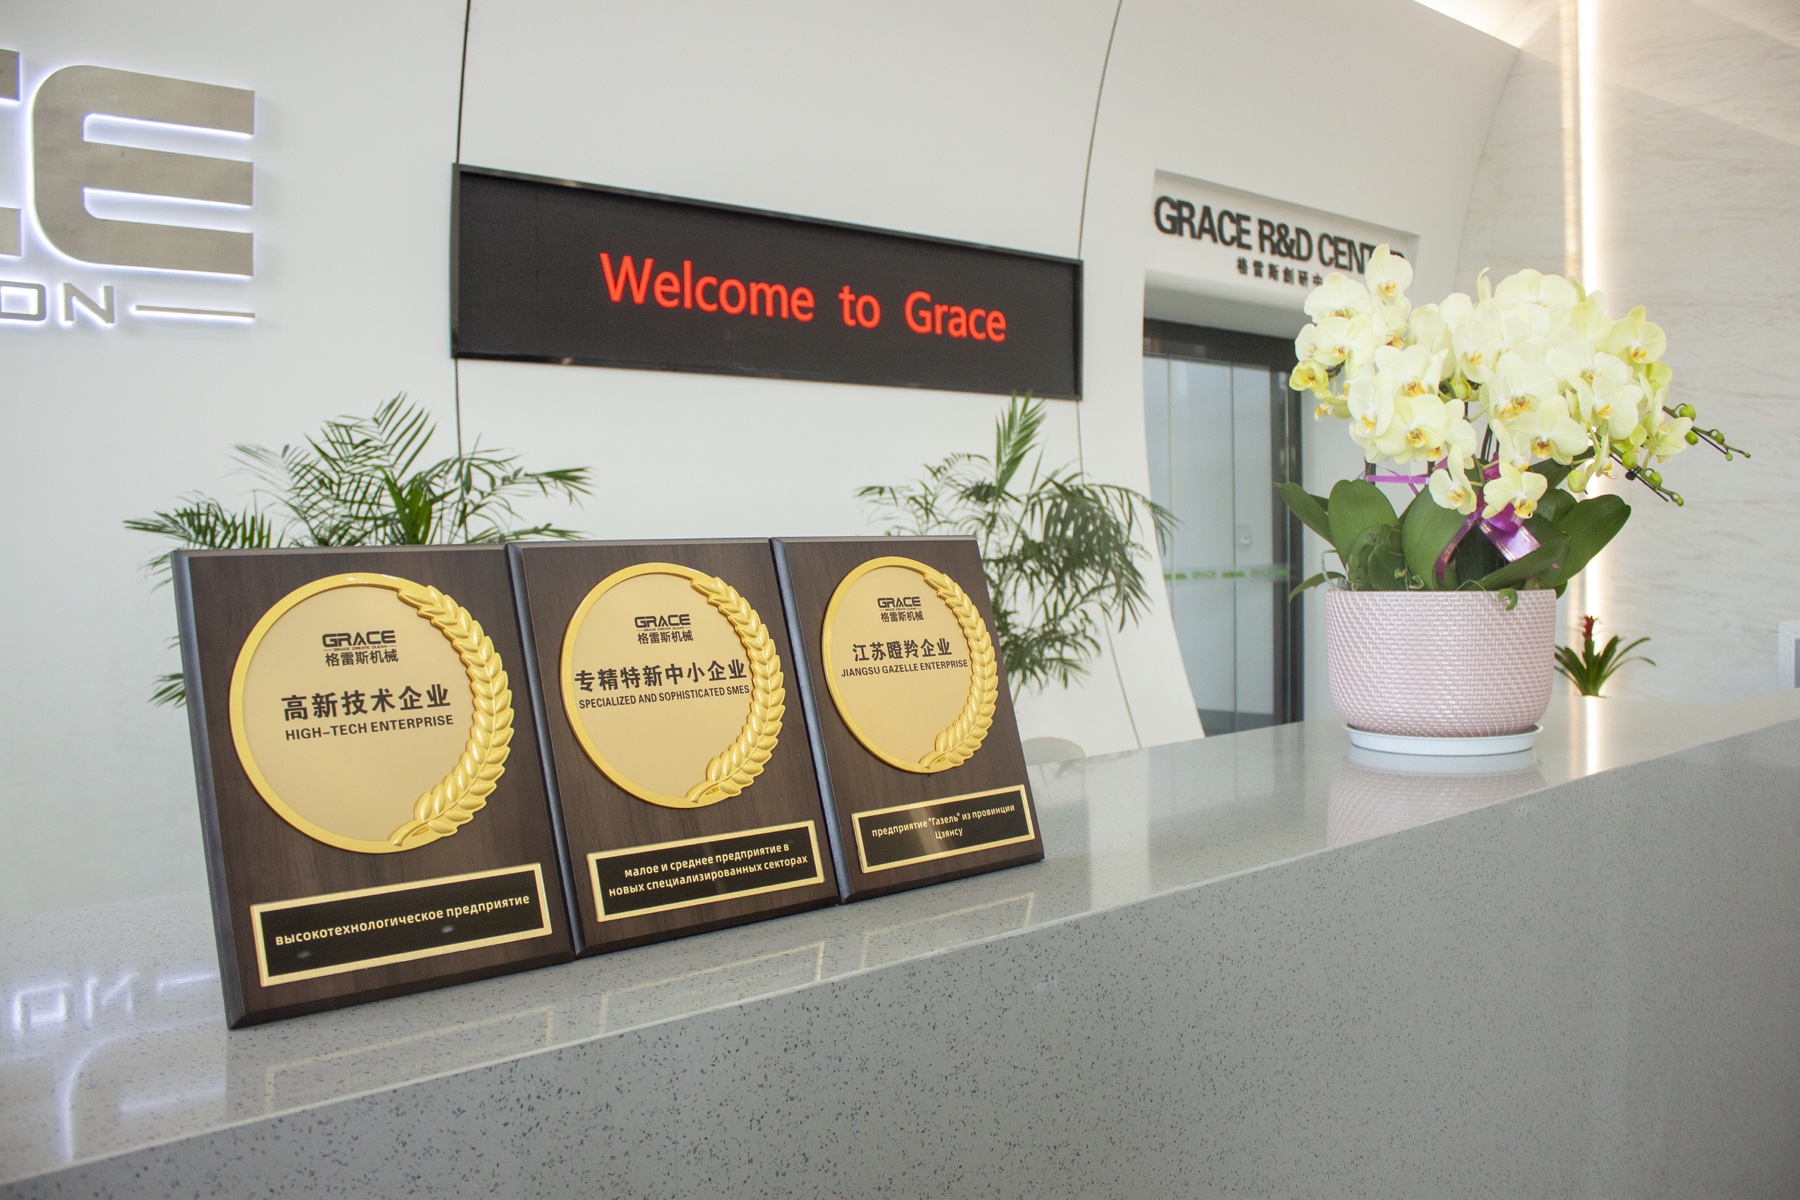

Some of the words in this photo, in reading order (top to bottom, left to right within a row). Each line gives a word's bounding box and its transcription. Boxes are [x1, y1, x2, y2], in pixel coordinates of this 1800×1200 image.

[0, 48, 255, 277] E
[1154, 196, 1252, 251] GRACE
[1258, 218, 1313, 262] R&D
[600, 252, 815, 322] Welcome
[839, 285, 881, 329] to
[904, 290, 1006, 342] Grace
[877, 596, 921, 608] GRACE
[634, 614, 691, 628] GRACE
[880, 610, 924, 623] 格雷斯机械
[322, 630, 396, 648] GRACE
[637, 630, 694, 645] 格雷斯机械
[853, 637, 952, 662] 江苏瞪羚企业
[325, 648, 399, 667] 格雷斯机械
[841, 665, 880, 677] JIANGSU
[882, 662, 919, 674] GAZELLE
[920, 659, 968, 671] ENTERPRISE
[574, 658, 747, 692] 专精特新中小企业
[281, 683, 451, 721] 高新技术企业
[579, 693, 636, 709] SPECIALIZED
[638, 693, 657, 704] AND
[658, 685, 725, 701] SOPHISTICATED
[726, 684, 750, 695] SMES
[285, 722, 368, 741] HIGH-TECH
[370, 714, 454, 733] ENTERPRISE
[871, 820, 928, 838] предприятие
[961, 811, 972, 821] из
[972, 803, 1016, 820] провинции
[935, 827, 963, 841] Цзянсу
[624, 865, 659, 878] малое
[661, 862, 669, 872] и
[670, 854, 714, 873] среднее
[715, 843, 782, 865] предприятие
[783, 843, 790, 852] в
[608, 882, 645, 897] новых
[646, 862, 763, 891] специализированных
[763, 854, 808, 872] секторах
[275, 907, 444, 946] высокотехнологическое
[446, 894, 530, 920] предприятие
